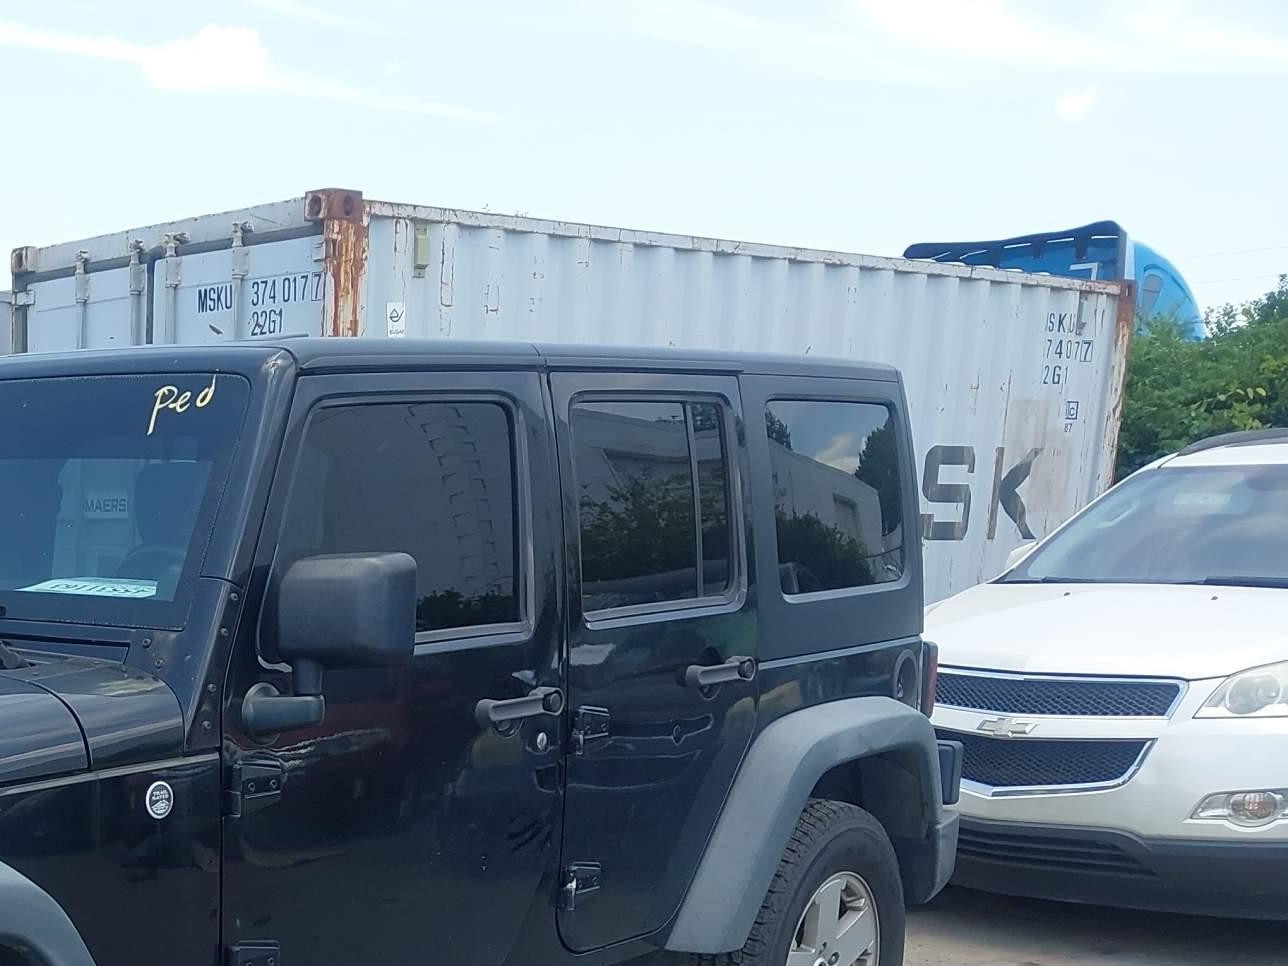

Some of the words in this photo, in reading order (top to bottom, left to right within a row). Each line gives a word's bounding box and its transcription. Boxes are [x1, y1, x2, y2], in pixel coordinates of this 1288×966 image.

[197, 284, 232, 313] MSKU
[251, 279, 276, 306] 374
[282, 275, 309, 303] 017
[250, 308, 283, 336] 22G1
